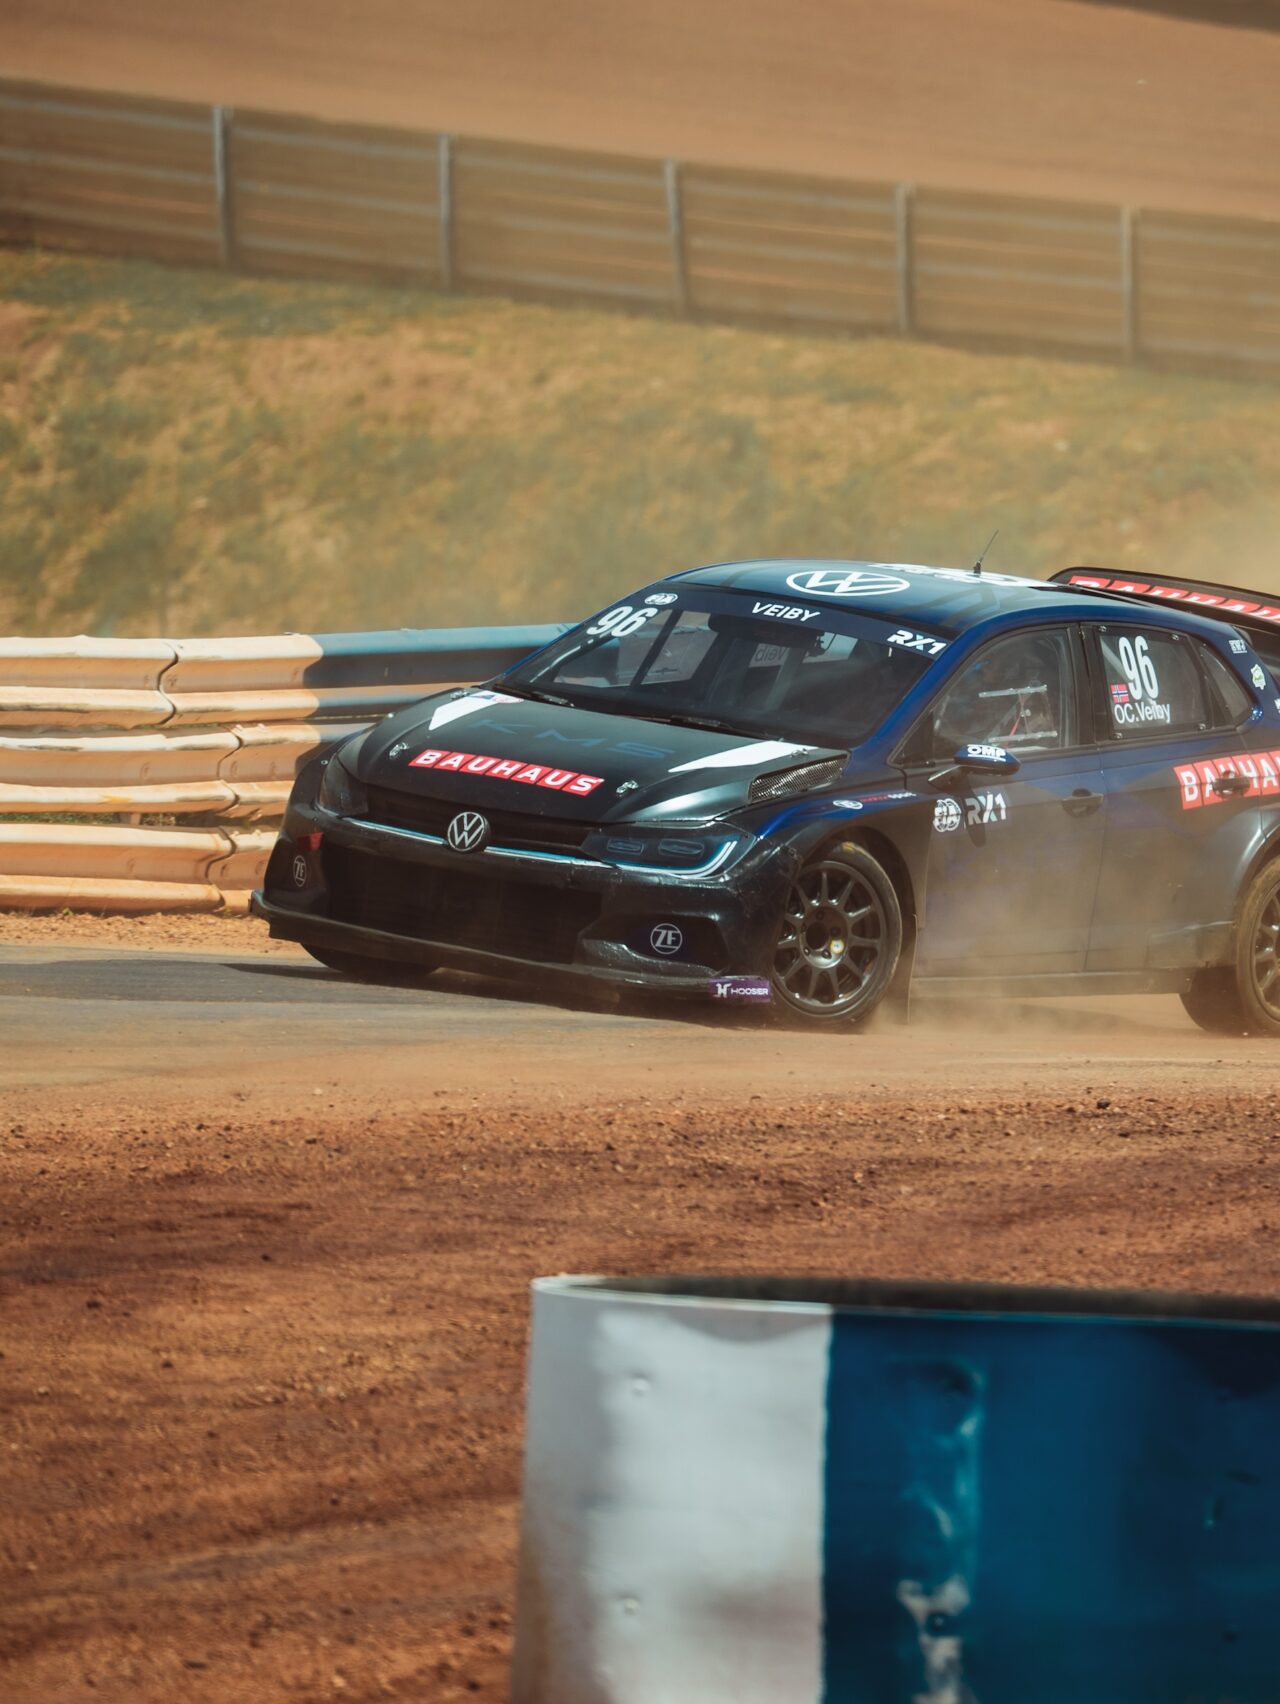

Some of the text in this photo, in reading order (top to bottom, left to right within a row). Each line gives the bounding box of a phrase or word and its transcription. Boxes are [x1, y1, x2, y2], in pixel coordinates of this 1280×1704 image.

[586, 605, 658, 637] 96
[752, 602, 821, 622] VEIBY
[887, 629, 947, 655] RX1
[1119, 636, 1159, 700] 96
[1114, 702, 1171, 724] OC.Veiby
[967, 745, 1006, 758] OMP
[415, 752, 603, 792] BAUHAUS
[965, 794, 1007, 825] RX1
[653, 928, 681, 949] ZF
